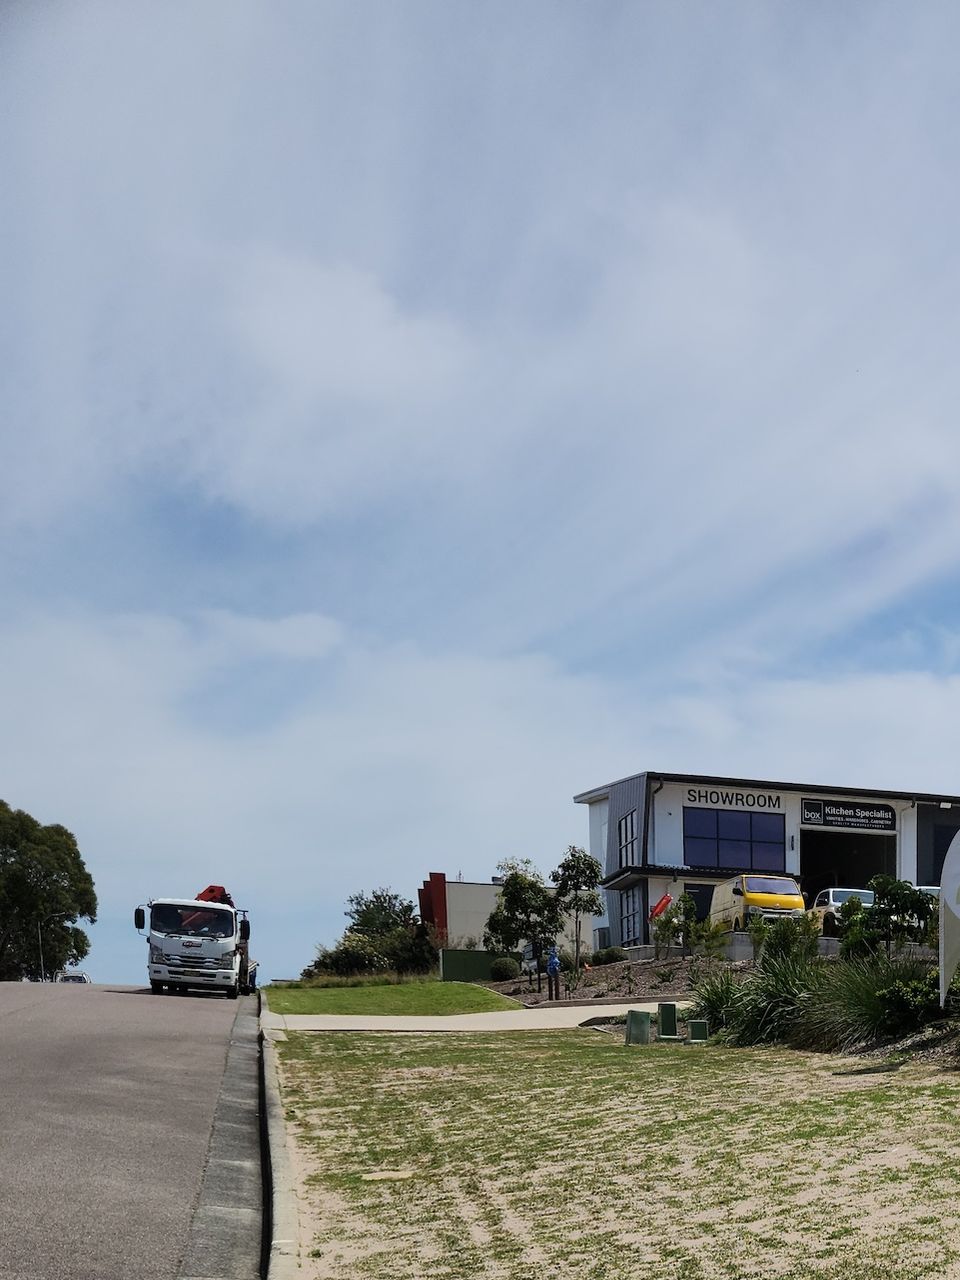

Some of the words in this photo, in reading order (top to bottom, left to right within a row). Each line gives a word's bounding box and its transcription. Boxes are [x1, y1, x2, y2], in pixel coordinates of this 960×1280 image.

[687, 789, 780, 808] SHOWROOM
[804, 809, 821, 819] box
[825, 806, 854, 815] Kitchen
[855, 809, 892, 819] Specialist
